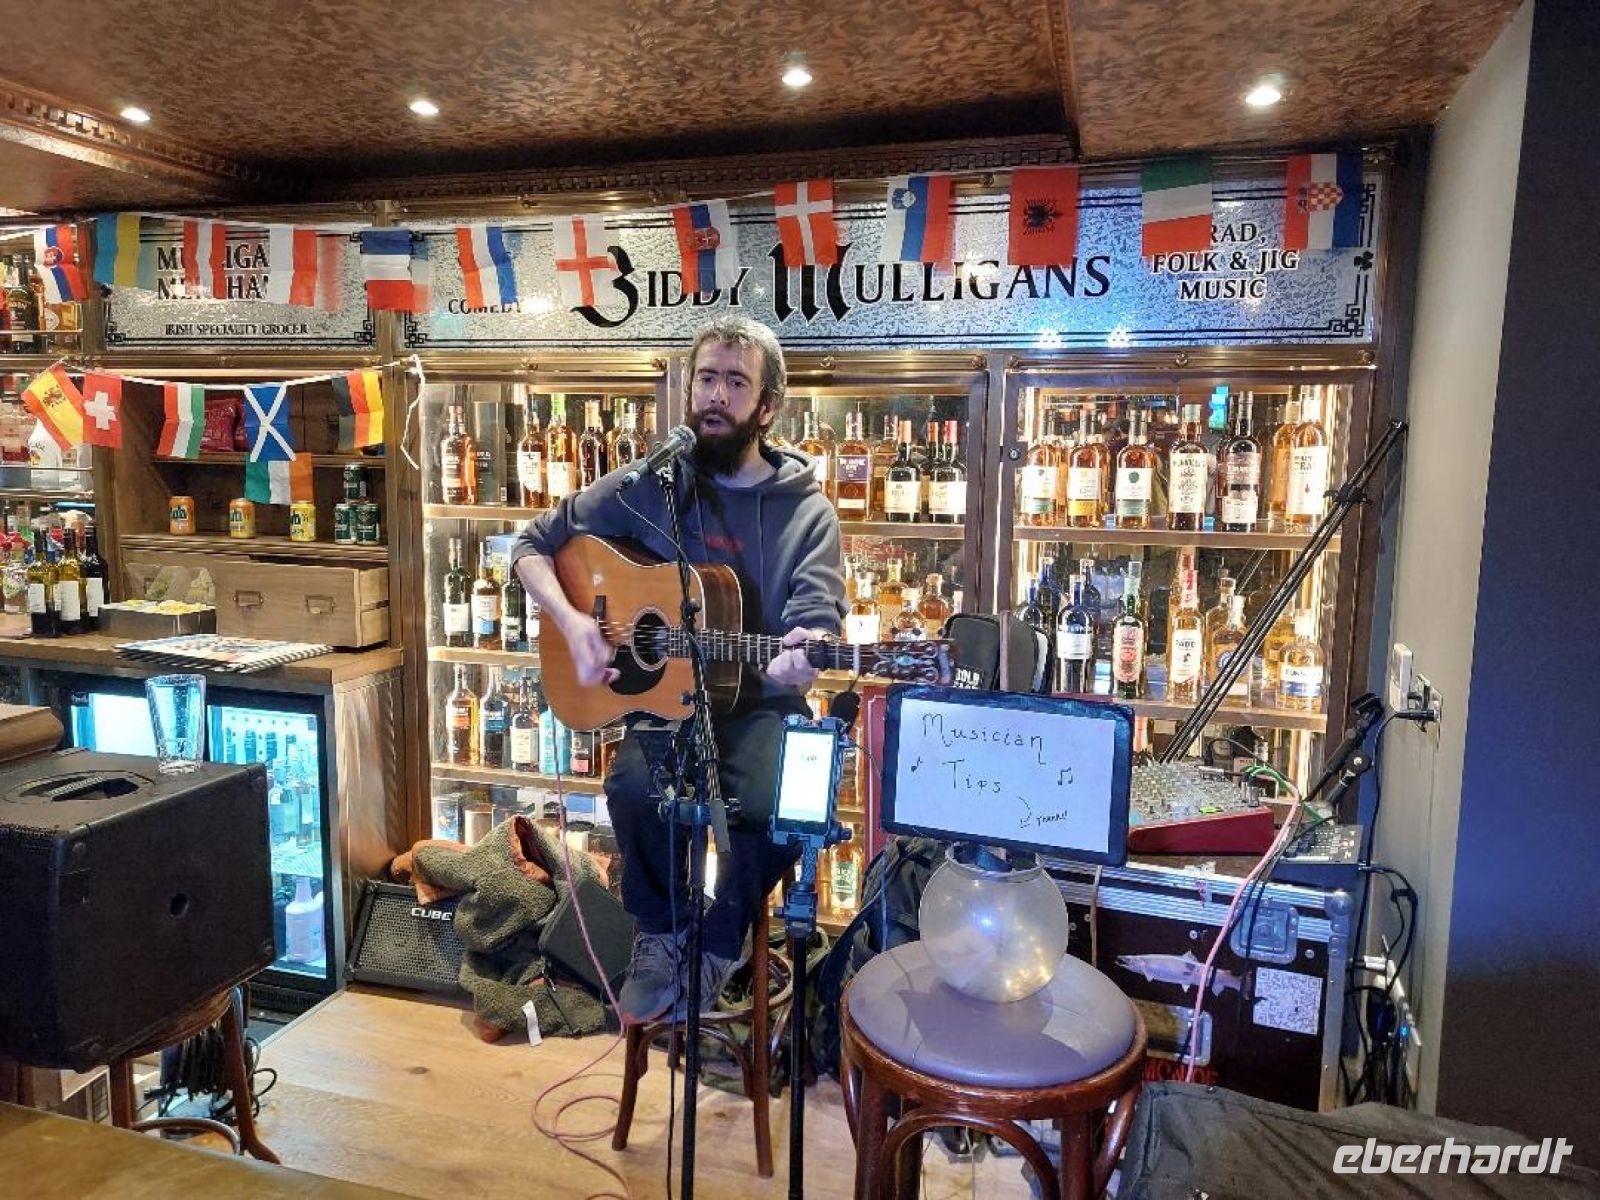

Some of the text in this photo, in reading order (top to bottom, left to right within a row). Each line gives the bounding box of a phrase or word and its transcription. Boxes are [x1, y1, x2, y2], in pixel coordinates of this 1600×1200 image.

[1210, 222, 1267, 246] RAD,
[1153, 250, 1299, 275] FOLK & JIG
[1180, 279, 1266, 300] MUSIC
[922, 712, 1047, 766] Musician
[941, 757, 1002, 796] Tips
